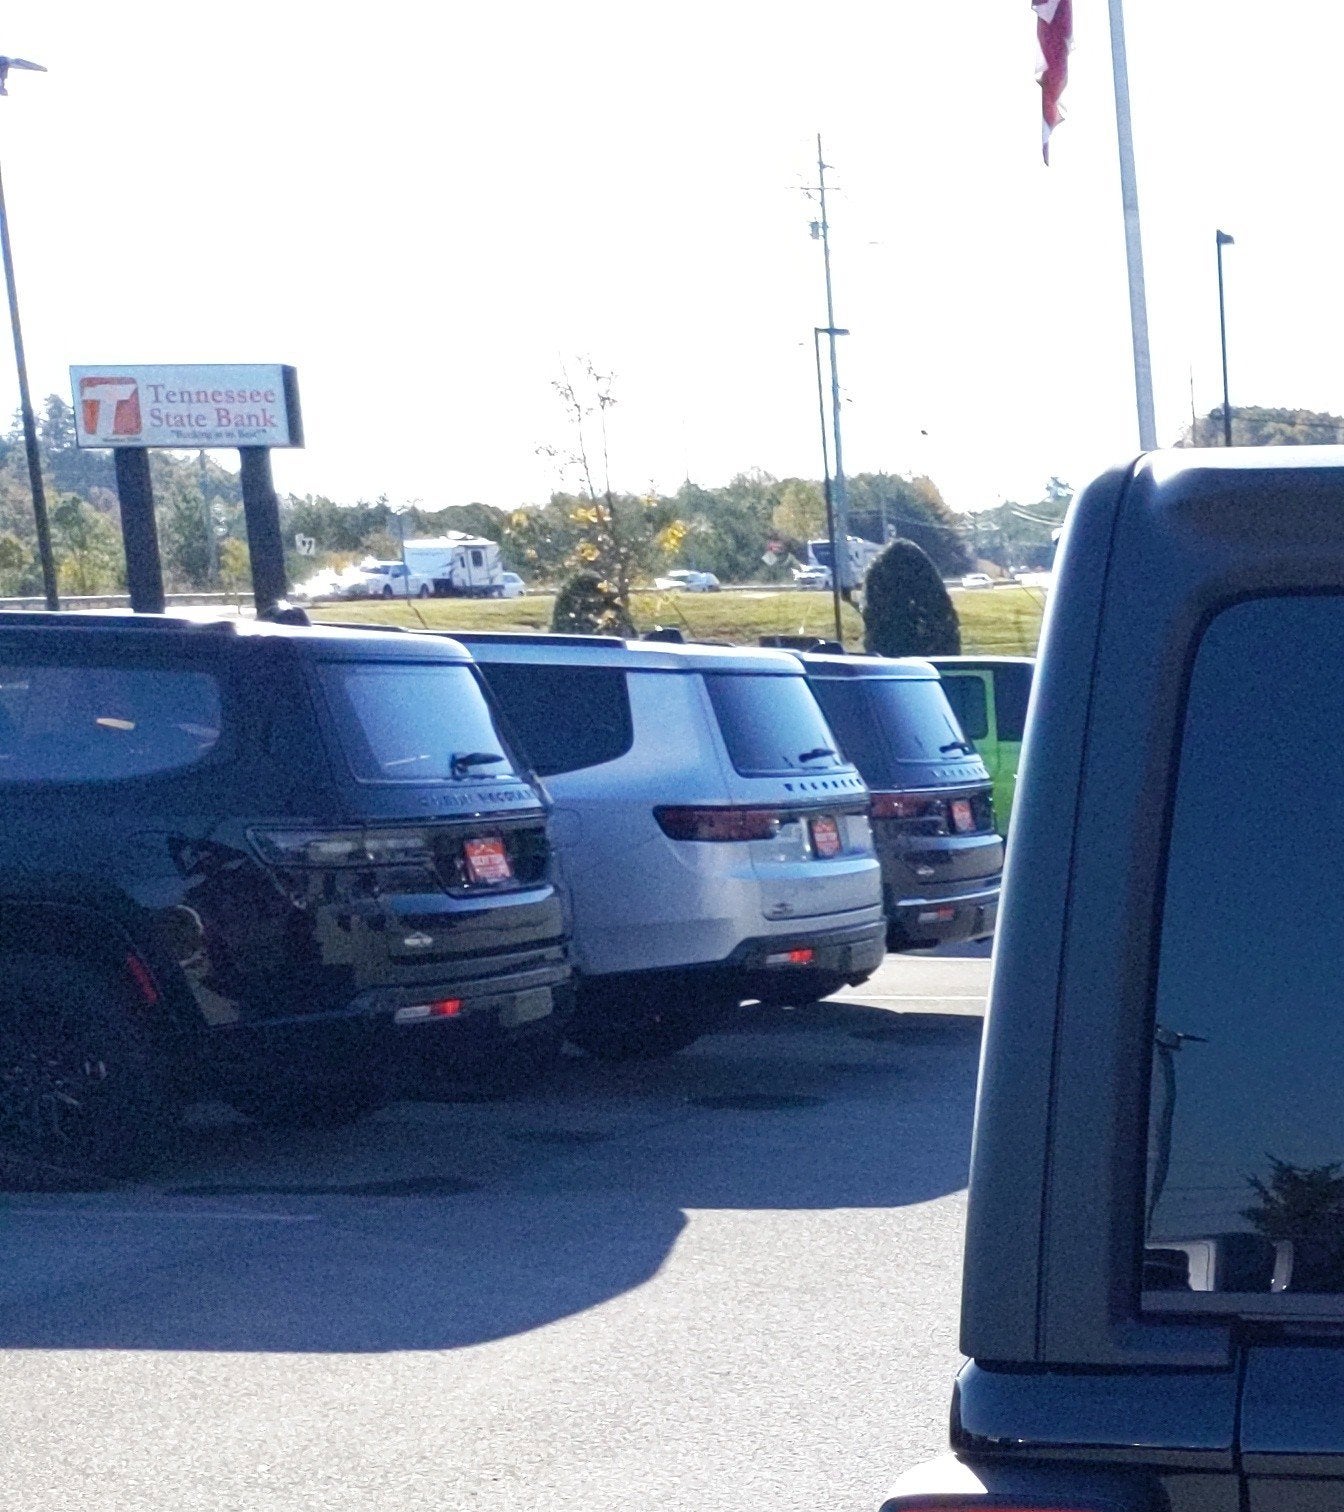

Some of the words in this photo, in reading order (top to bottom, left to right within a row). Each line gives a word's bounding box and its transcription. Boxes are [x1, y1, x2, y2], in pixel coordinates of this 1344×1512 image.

[146, 384, 276, 404] Tennessee
[150, 408, 208, 428] State
[215, 408, 278, 428] Bank
